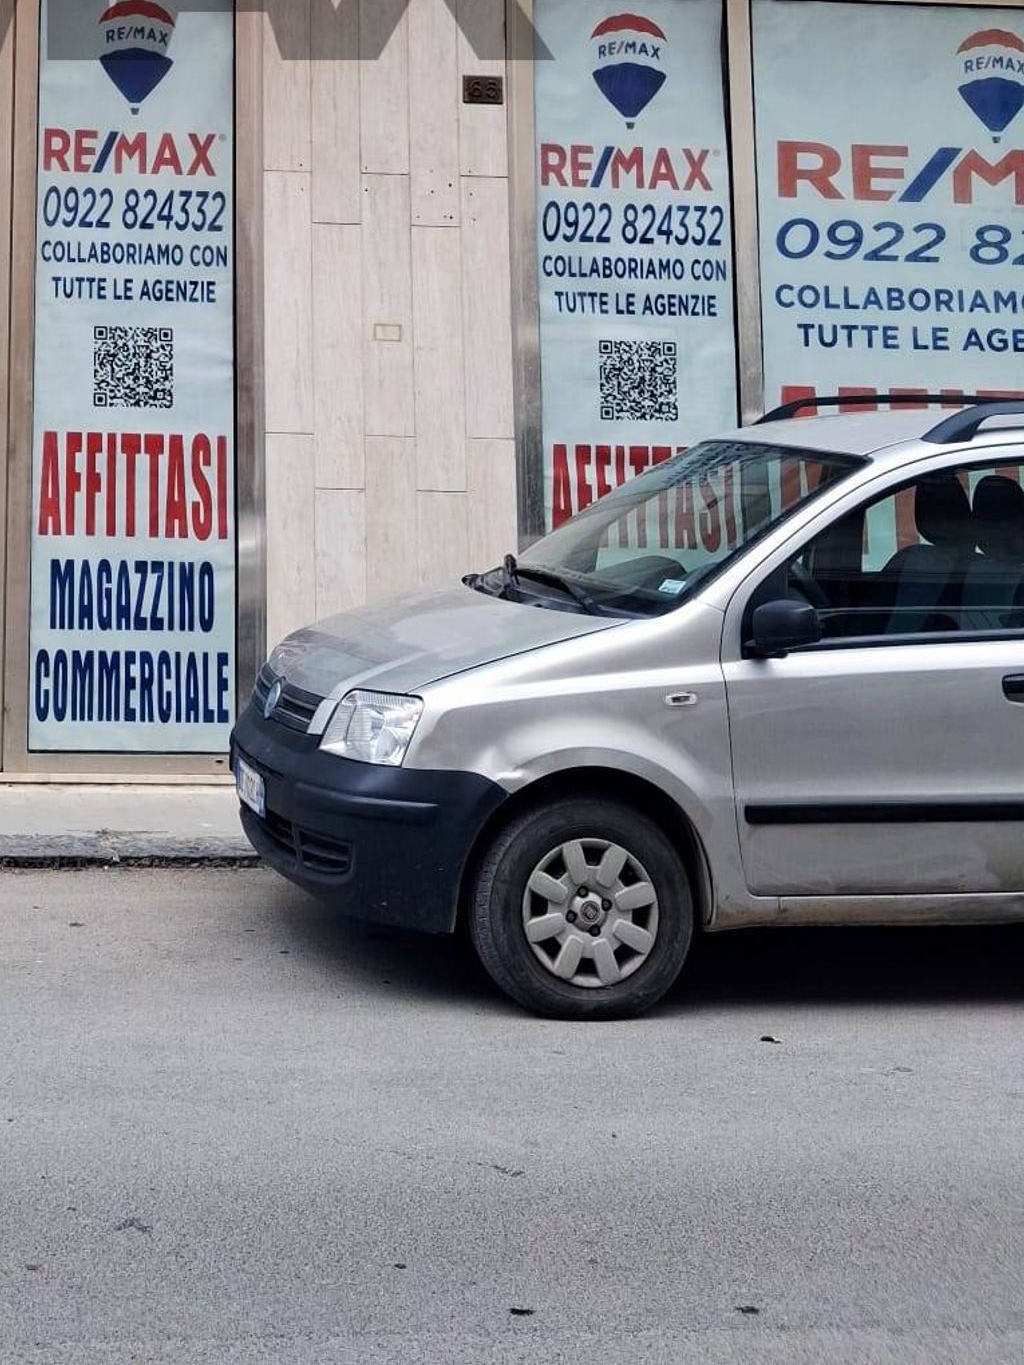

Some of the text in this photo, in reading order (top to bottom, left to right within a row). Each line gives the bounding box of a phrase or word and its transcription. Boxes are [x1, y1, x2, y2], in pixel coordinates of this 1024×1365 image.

[105, 26, 169, 47] RE/MAX
[598, 39, 662, 60] RE/MAX
[44, 129, 215, 176] RE/MAX
[541, 143, 712, 190] RE/MAX
[43, 186, 226, 231] 0922 824332
[543, 201, 723, 246] 0922 824332
[41, 240, 227, 267] COLLABORIAMO CON
[776, 218, 946, 262] 0922
[543, 255, 726, 281] COLLABORIAMO CON
[52, 277, 215, 302] TUTTE LE AGENZIE
[555, 291, 717, 316] TUTTE LE AGENZIE
[775, 284, 1024, 313] COLLABORIAM
[797, 324, 899, 349] TUTTE
[913, 327, 949, 350] LE
[39, 431, 227, 541] AFFITTASI
[50, 559, 214, 632] MAGAZZINO
[35, 649, 229, 723] COMMERCIALE
